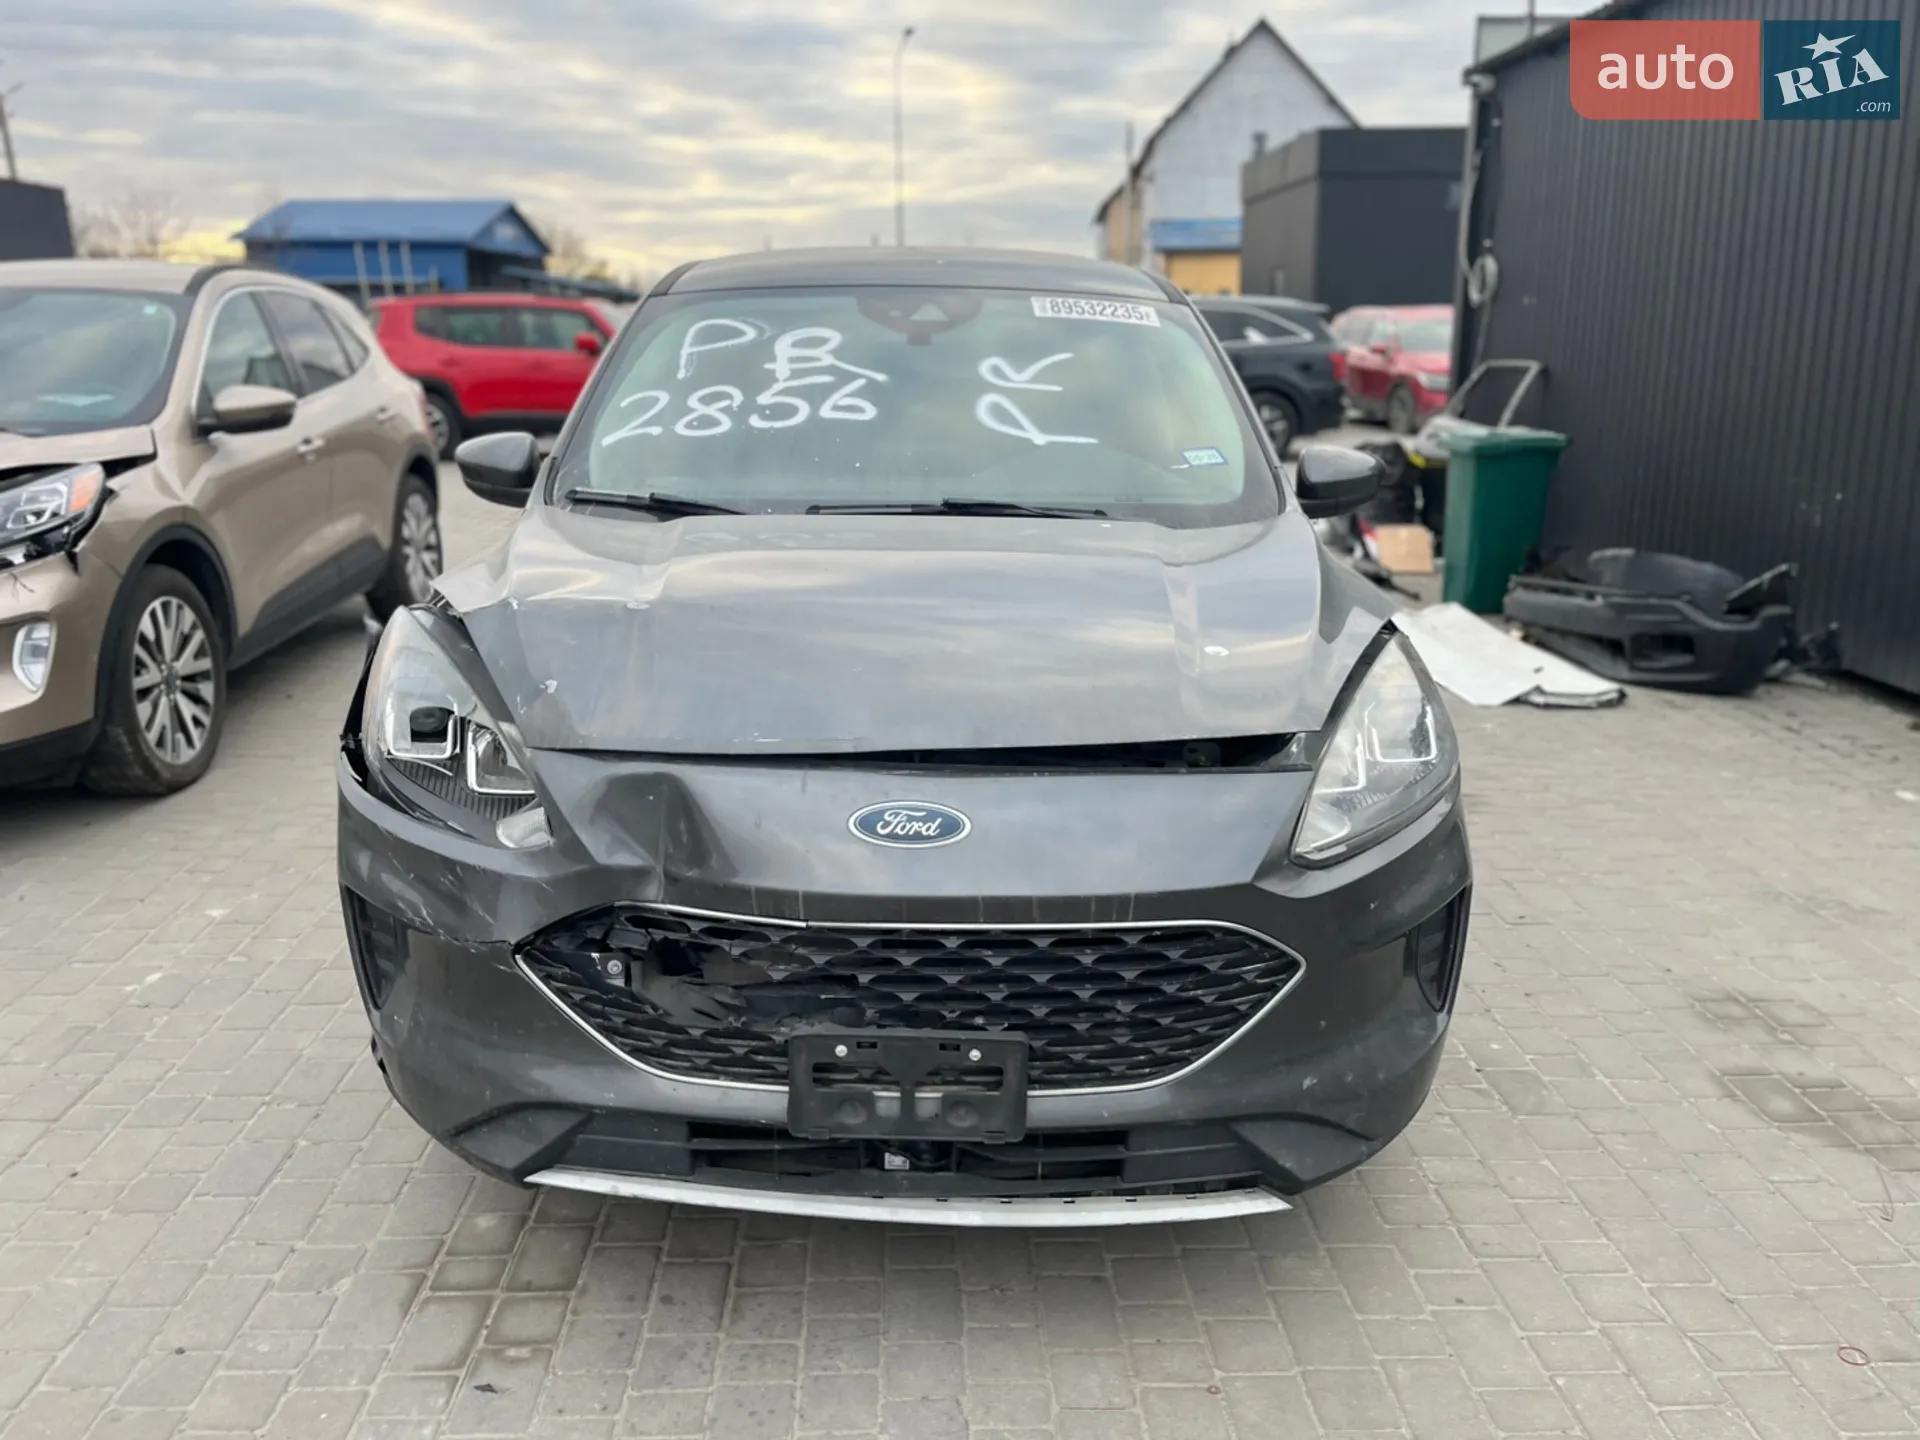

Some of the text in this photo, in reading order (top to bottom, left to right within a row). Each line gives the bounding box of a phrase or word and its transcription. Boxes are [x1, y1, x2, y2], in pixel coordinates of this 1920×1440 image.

[1049, 299, 1145, 321] 89532235
[600, 374, 878, 447] 2856
[876, 809, 942, 836] Ford
